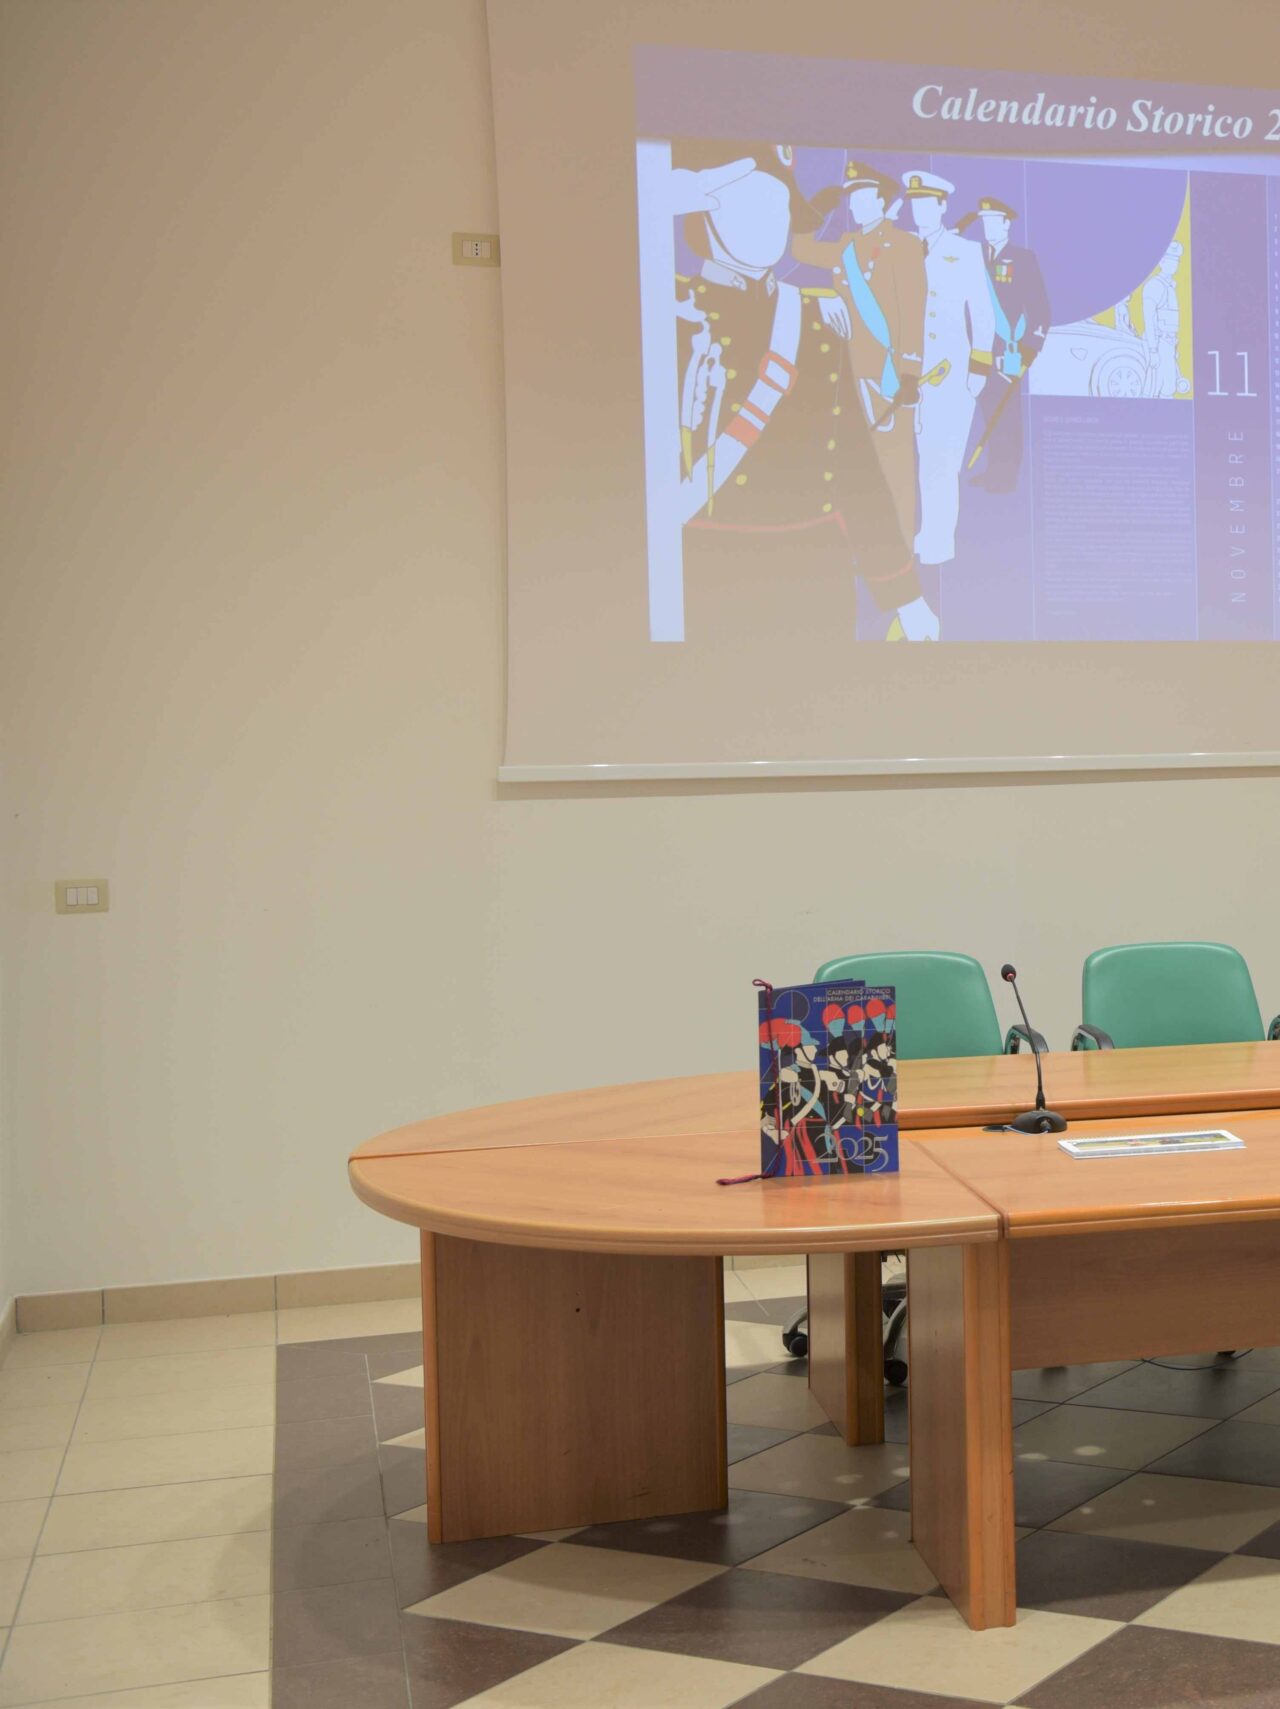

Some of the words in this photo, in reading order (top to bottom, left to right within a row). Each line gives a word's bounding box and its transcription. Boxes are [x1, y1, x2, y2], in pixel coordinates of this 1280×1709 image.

[912, 85, 1118, 130] Calendario
[1126, 98, 1254, 140] Storico
[1207, 350, 1258, 398] 11
[1228, 431, 1247, 604] NOVEMBRE
[827, 988, 864, 996] CALENDARIO
[813, 1132, 890, 1172] 2025
